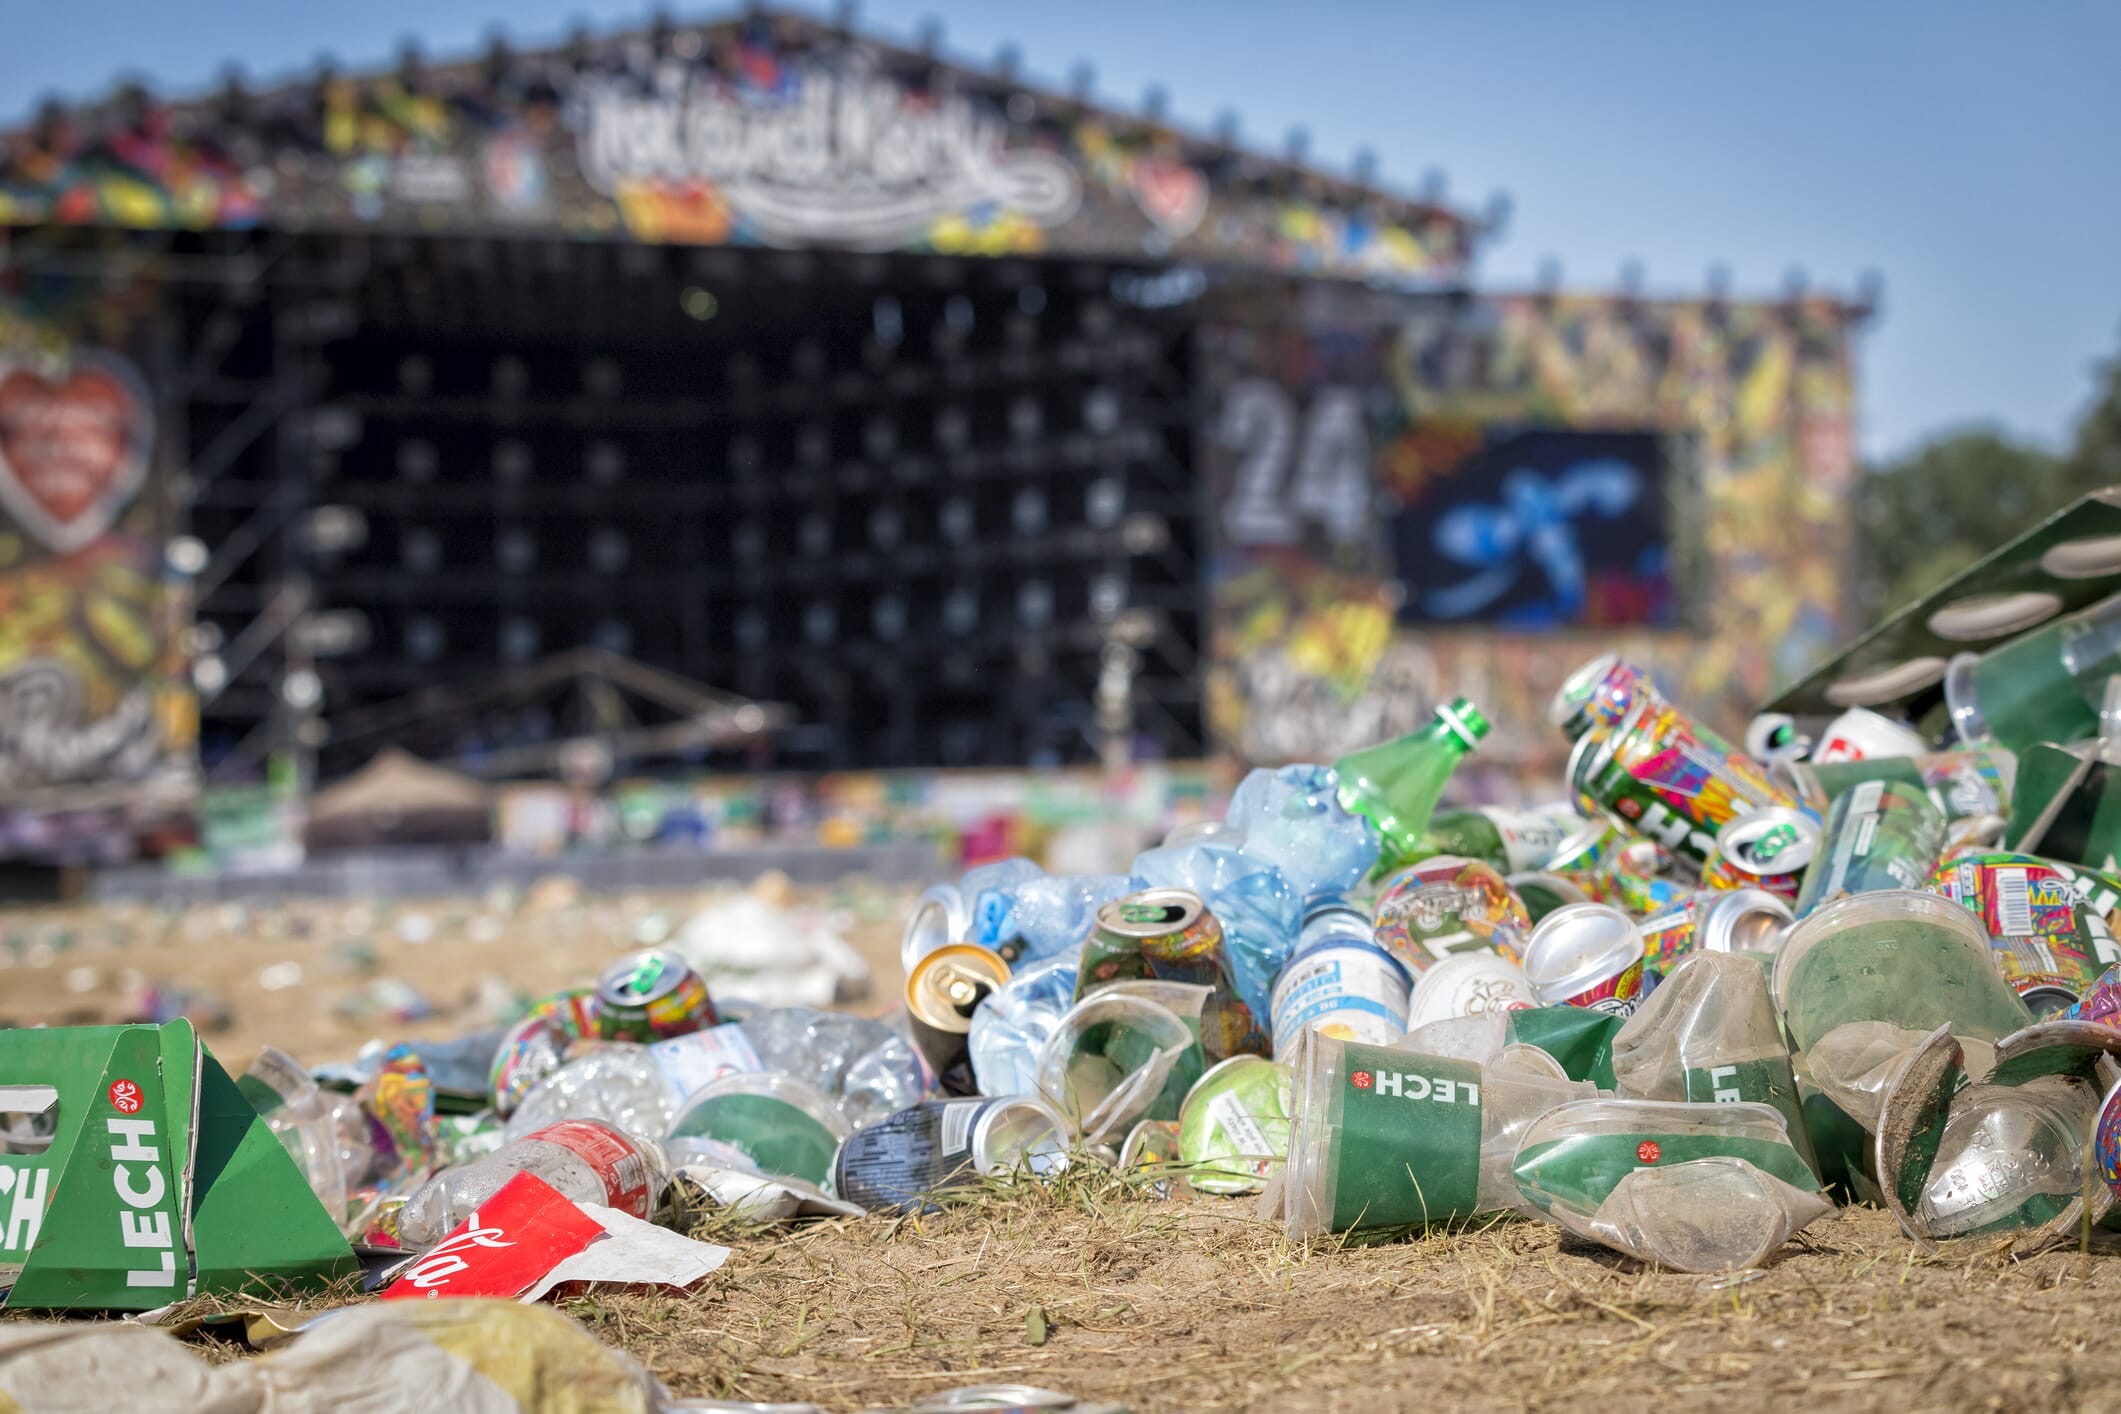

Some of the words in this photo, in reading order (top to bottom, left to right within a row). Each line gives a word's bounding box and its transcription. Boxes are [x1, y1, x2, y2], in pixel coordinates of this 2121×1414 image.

[1212, 377, 1370, 540] 24
[1375, 1070, 1479, 1106] LECH
[106, 1117, 176, 1288] LECH
